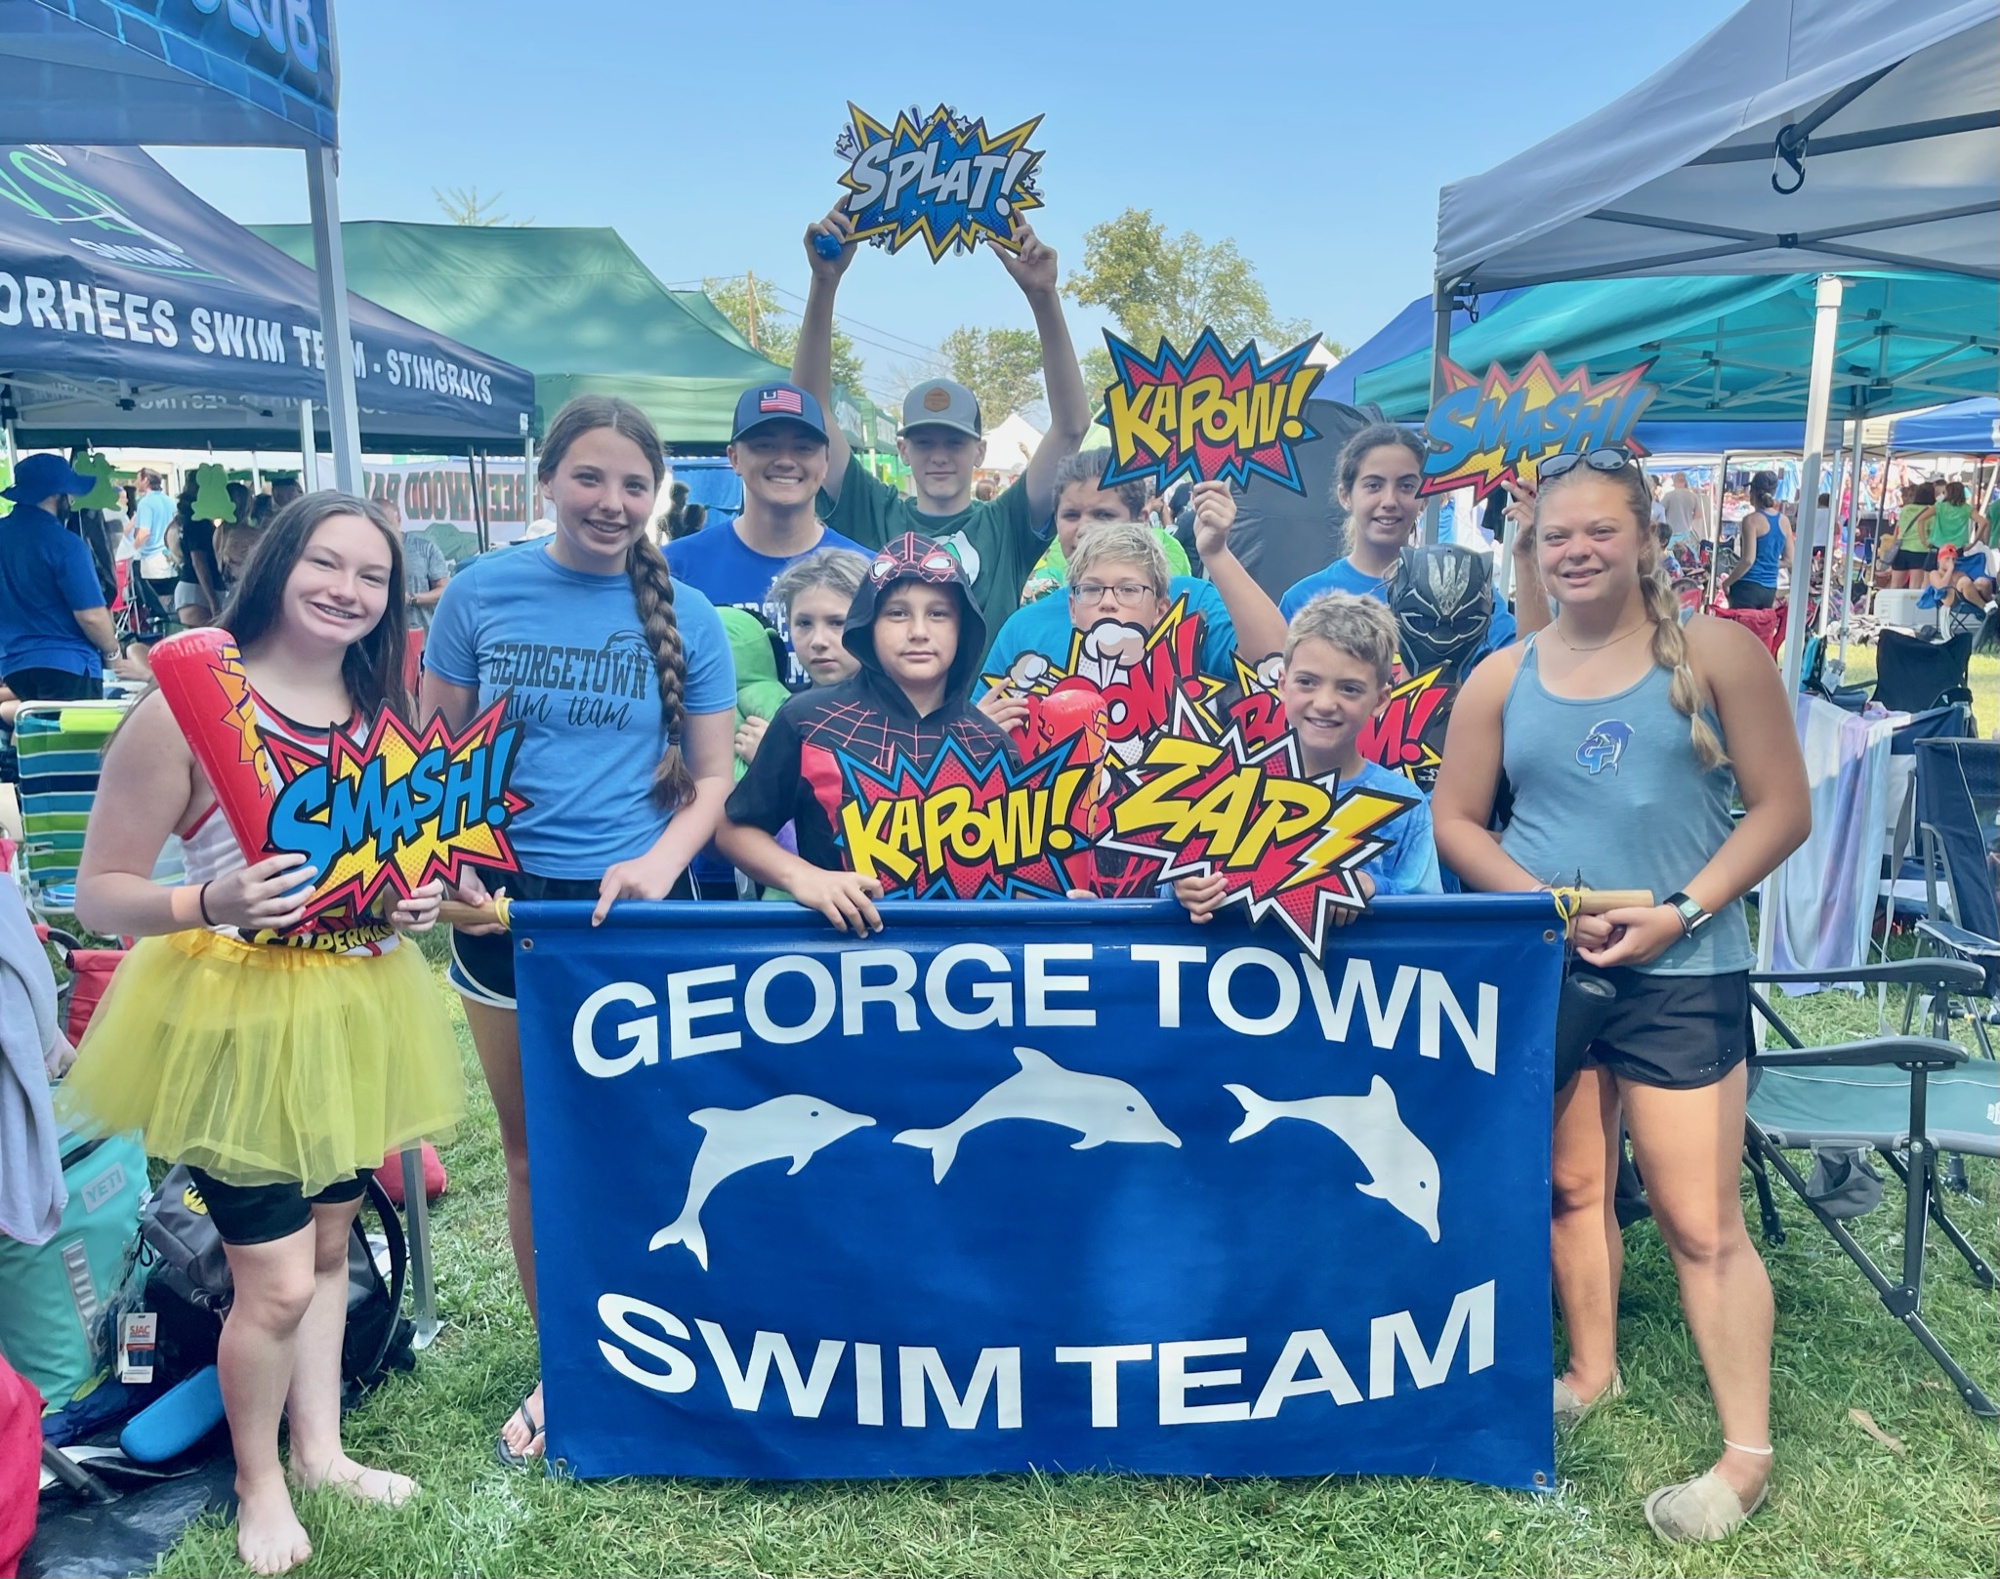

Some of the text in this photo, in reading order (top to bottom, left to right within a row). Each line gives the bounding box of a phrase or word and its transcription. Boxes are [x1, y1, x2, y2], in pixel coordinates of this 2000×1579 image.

[849, 139, 1031, 217] SPLAT!
[190, 307, 286, 363] SWIM
[293, 325, 366, 379] TEM
[386, 348, 493, 405] STINGRAYS
[1109, 368, 1319, 468] KAPOW!
[1423, 385, 1650, 475] SMASH!
[489, 643, 649, 700] GEORGETOWN
[568, 695, 633, 731] team
[1010, 614, 1202, 763] OM!
[1229, 687, 1448, 766] BM!
[271, 727, 517, 898] SMASH!
[841, 767, 1087, 882] KAPOW!
[86, 1169, 122, 1203] YETI
[129, 1325, 150, 1335] SJAC
[597, 1279, 1495, 1430] SWIM TEAM
